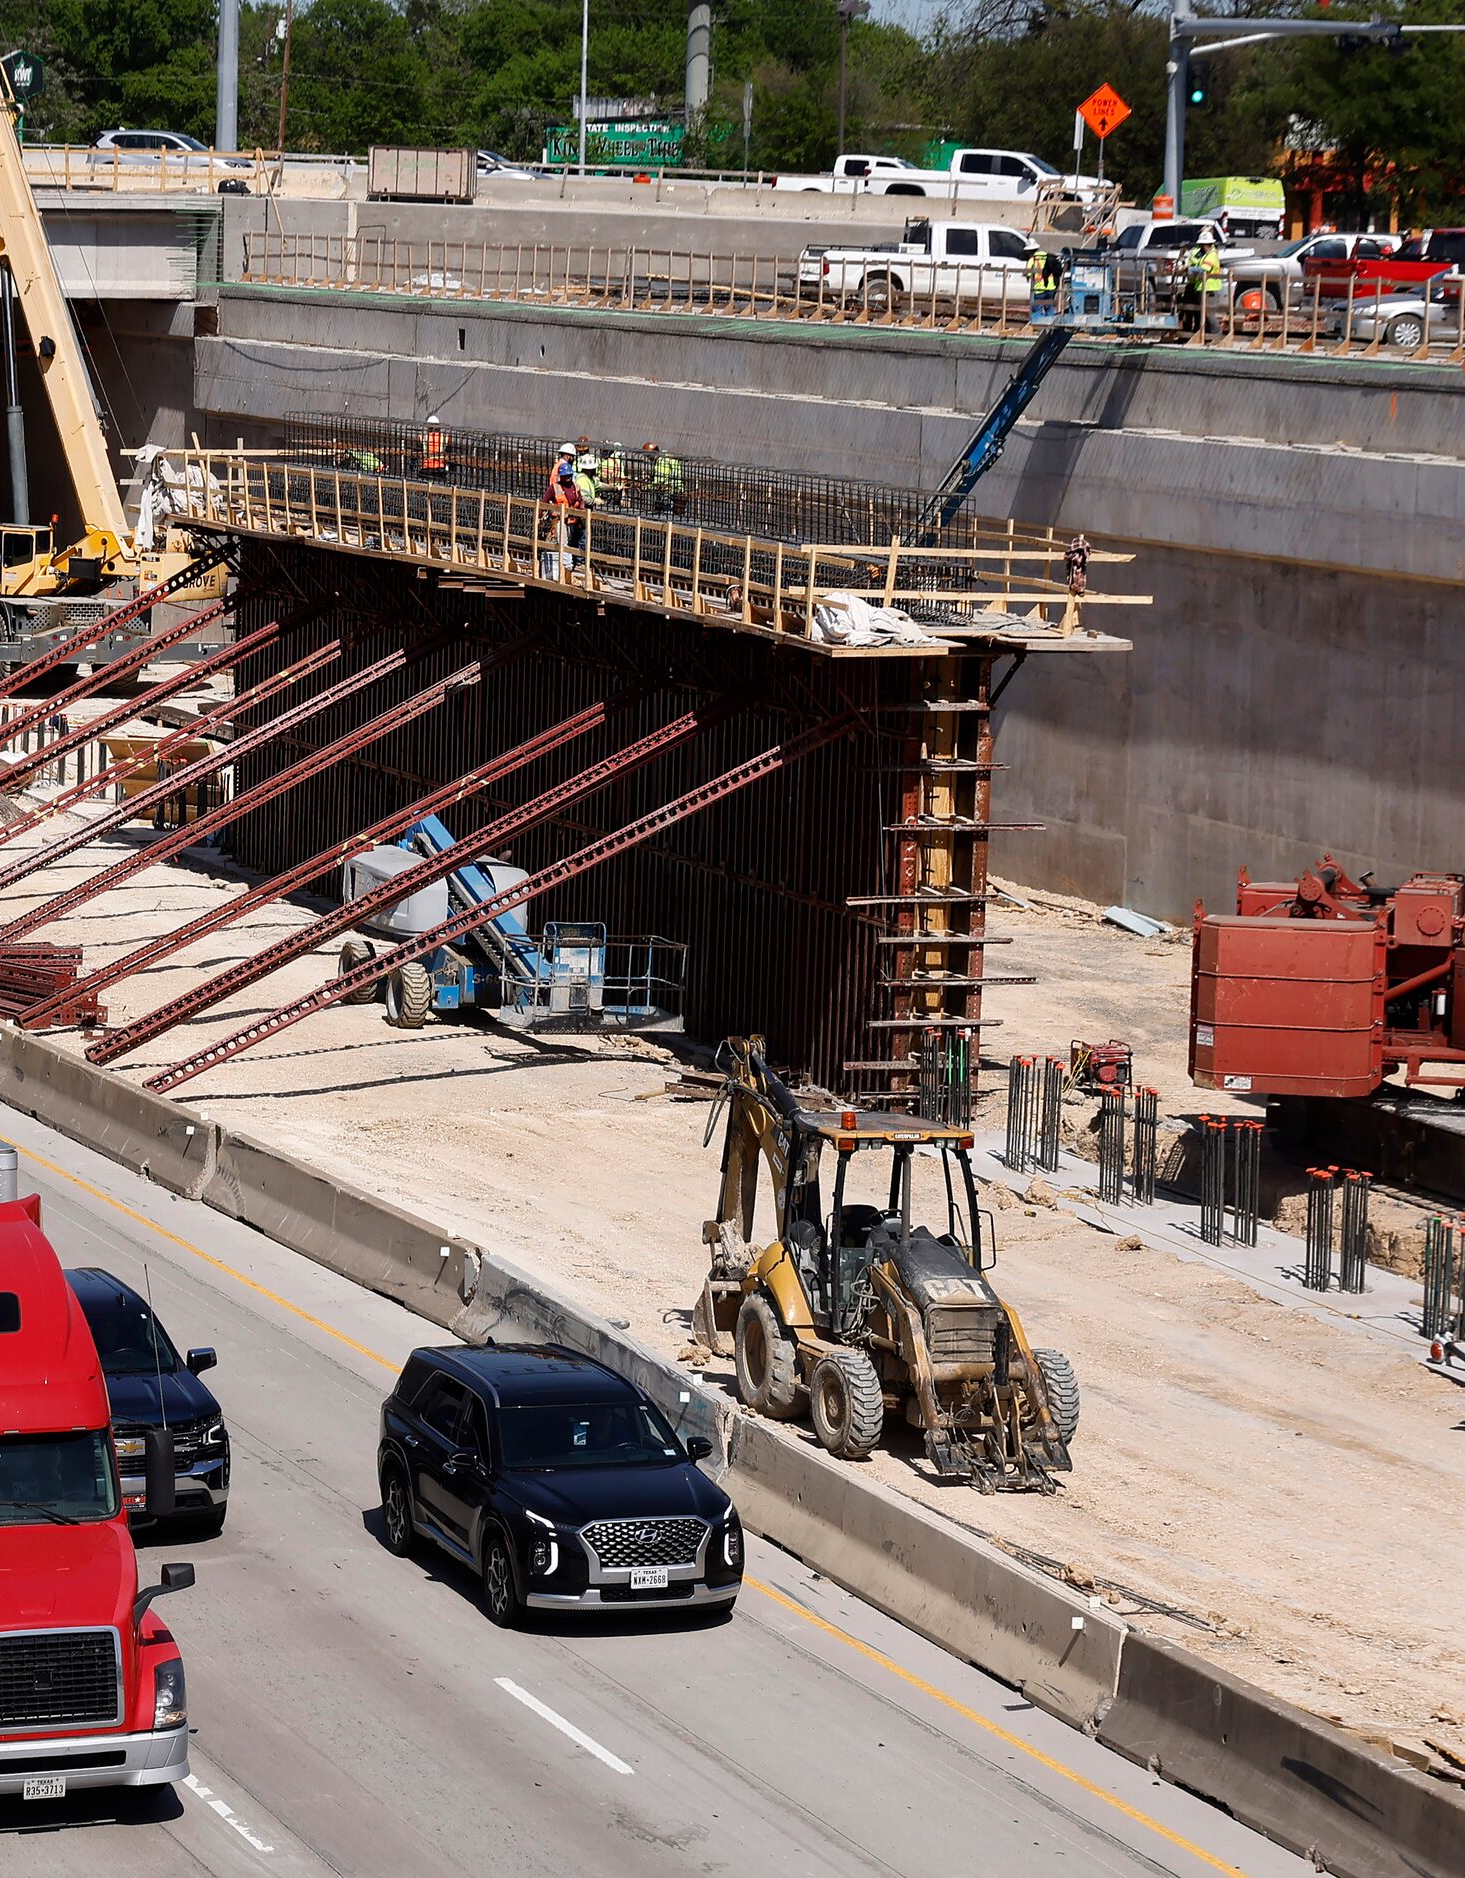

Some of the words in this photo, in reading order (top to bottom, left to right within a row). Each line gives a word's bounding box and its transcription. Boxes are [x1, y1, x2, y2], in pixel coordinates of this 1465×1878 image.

[1093, 108, 1115, 116] LINES
[585, 124, 609, 133] TATE
[552, 138, 580, 157] KIN
[778, 1131, 790, 1157] CAT
[923, 1279, 987, 1301] CAT
